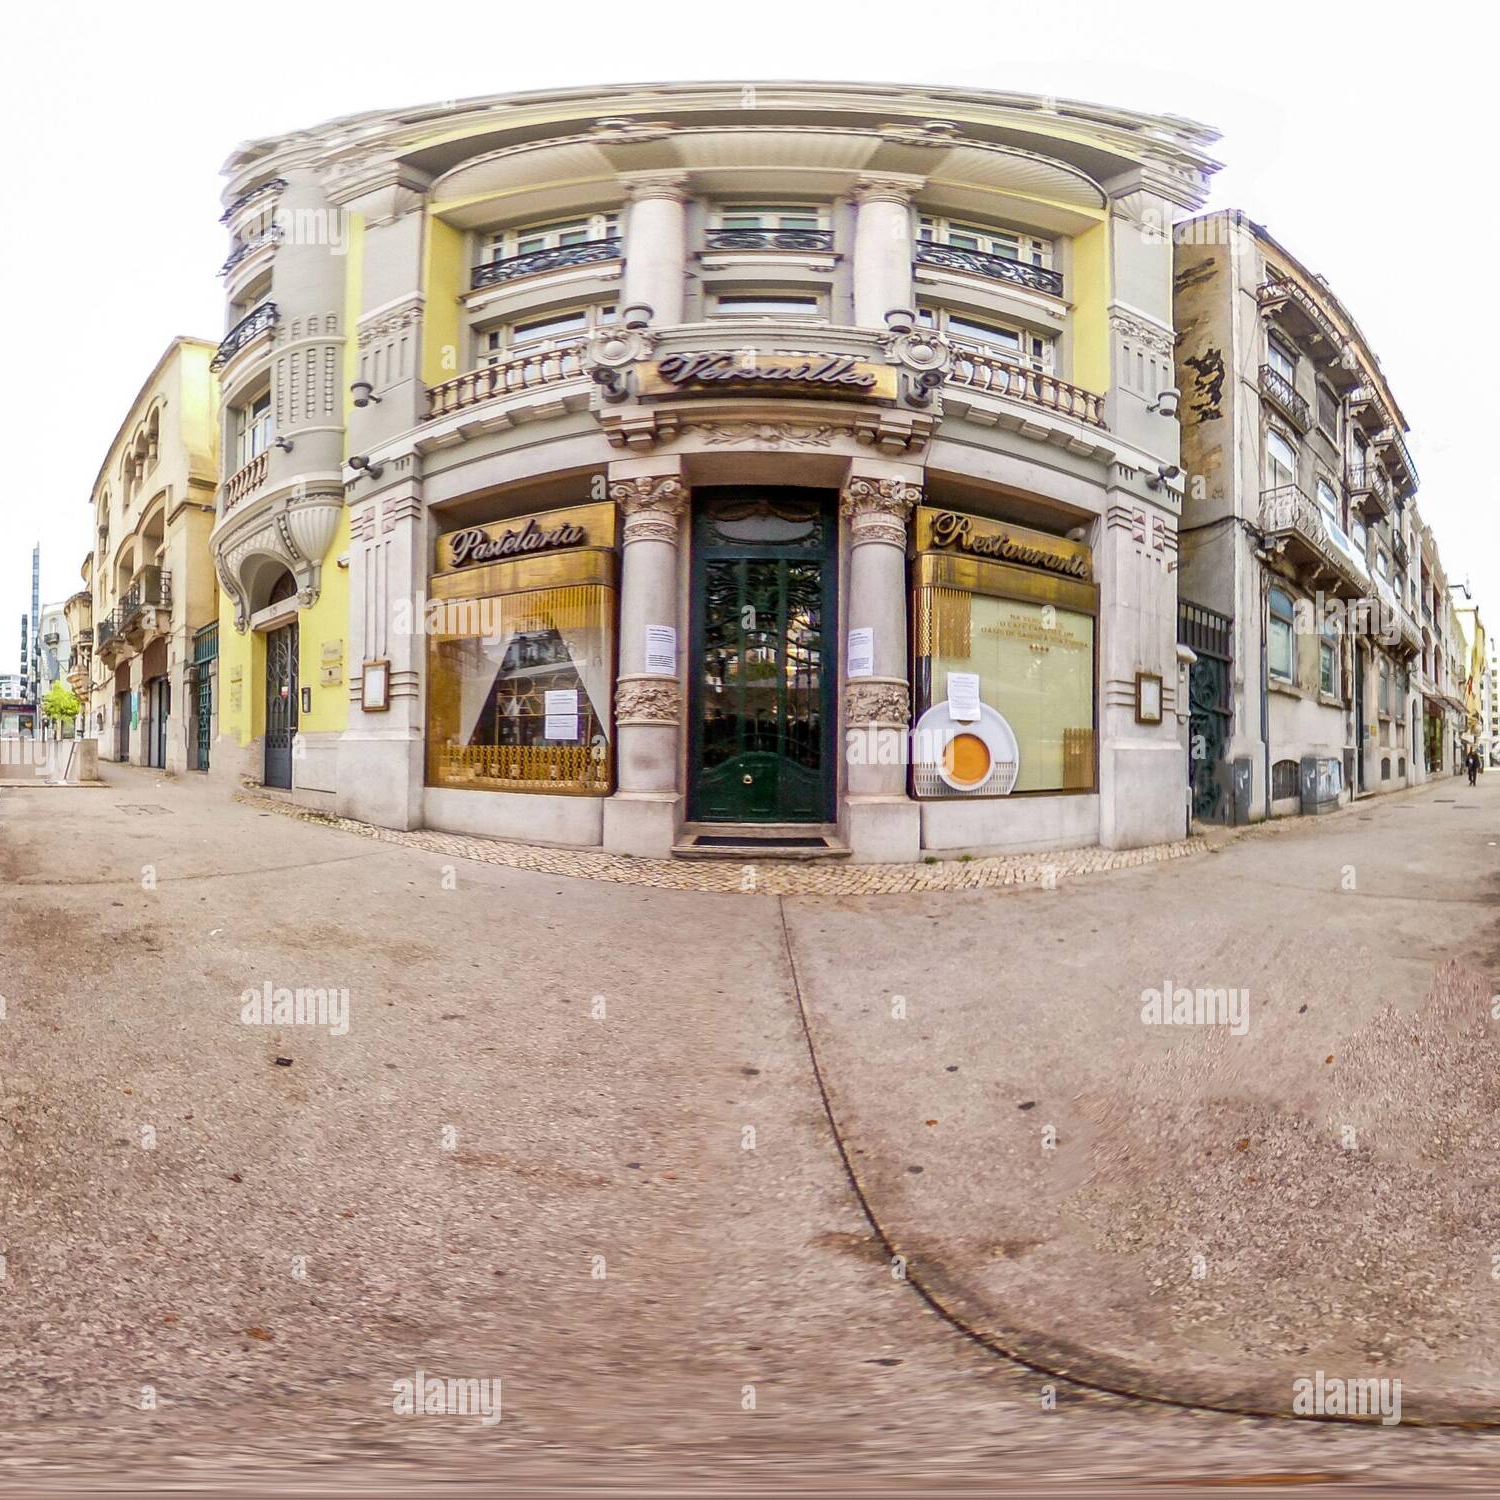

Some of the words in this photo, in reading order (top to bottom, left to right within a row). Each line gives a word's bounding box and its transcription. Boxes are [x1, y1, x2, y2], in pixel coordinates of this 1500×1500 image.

[658, 354, 877, 387] Versailles
[450, 518, 584, 568] Pastelaria
[930, 512, 1089, 577] Restaurante
